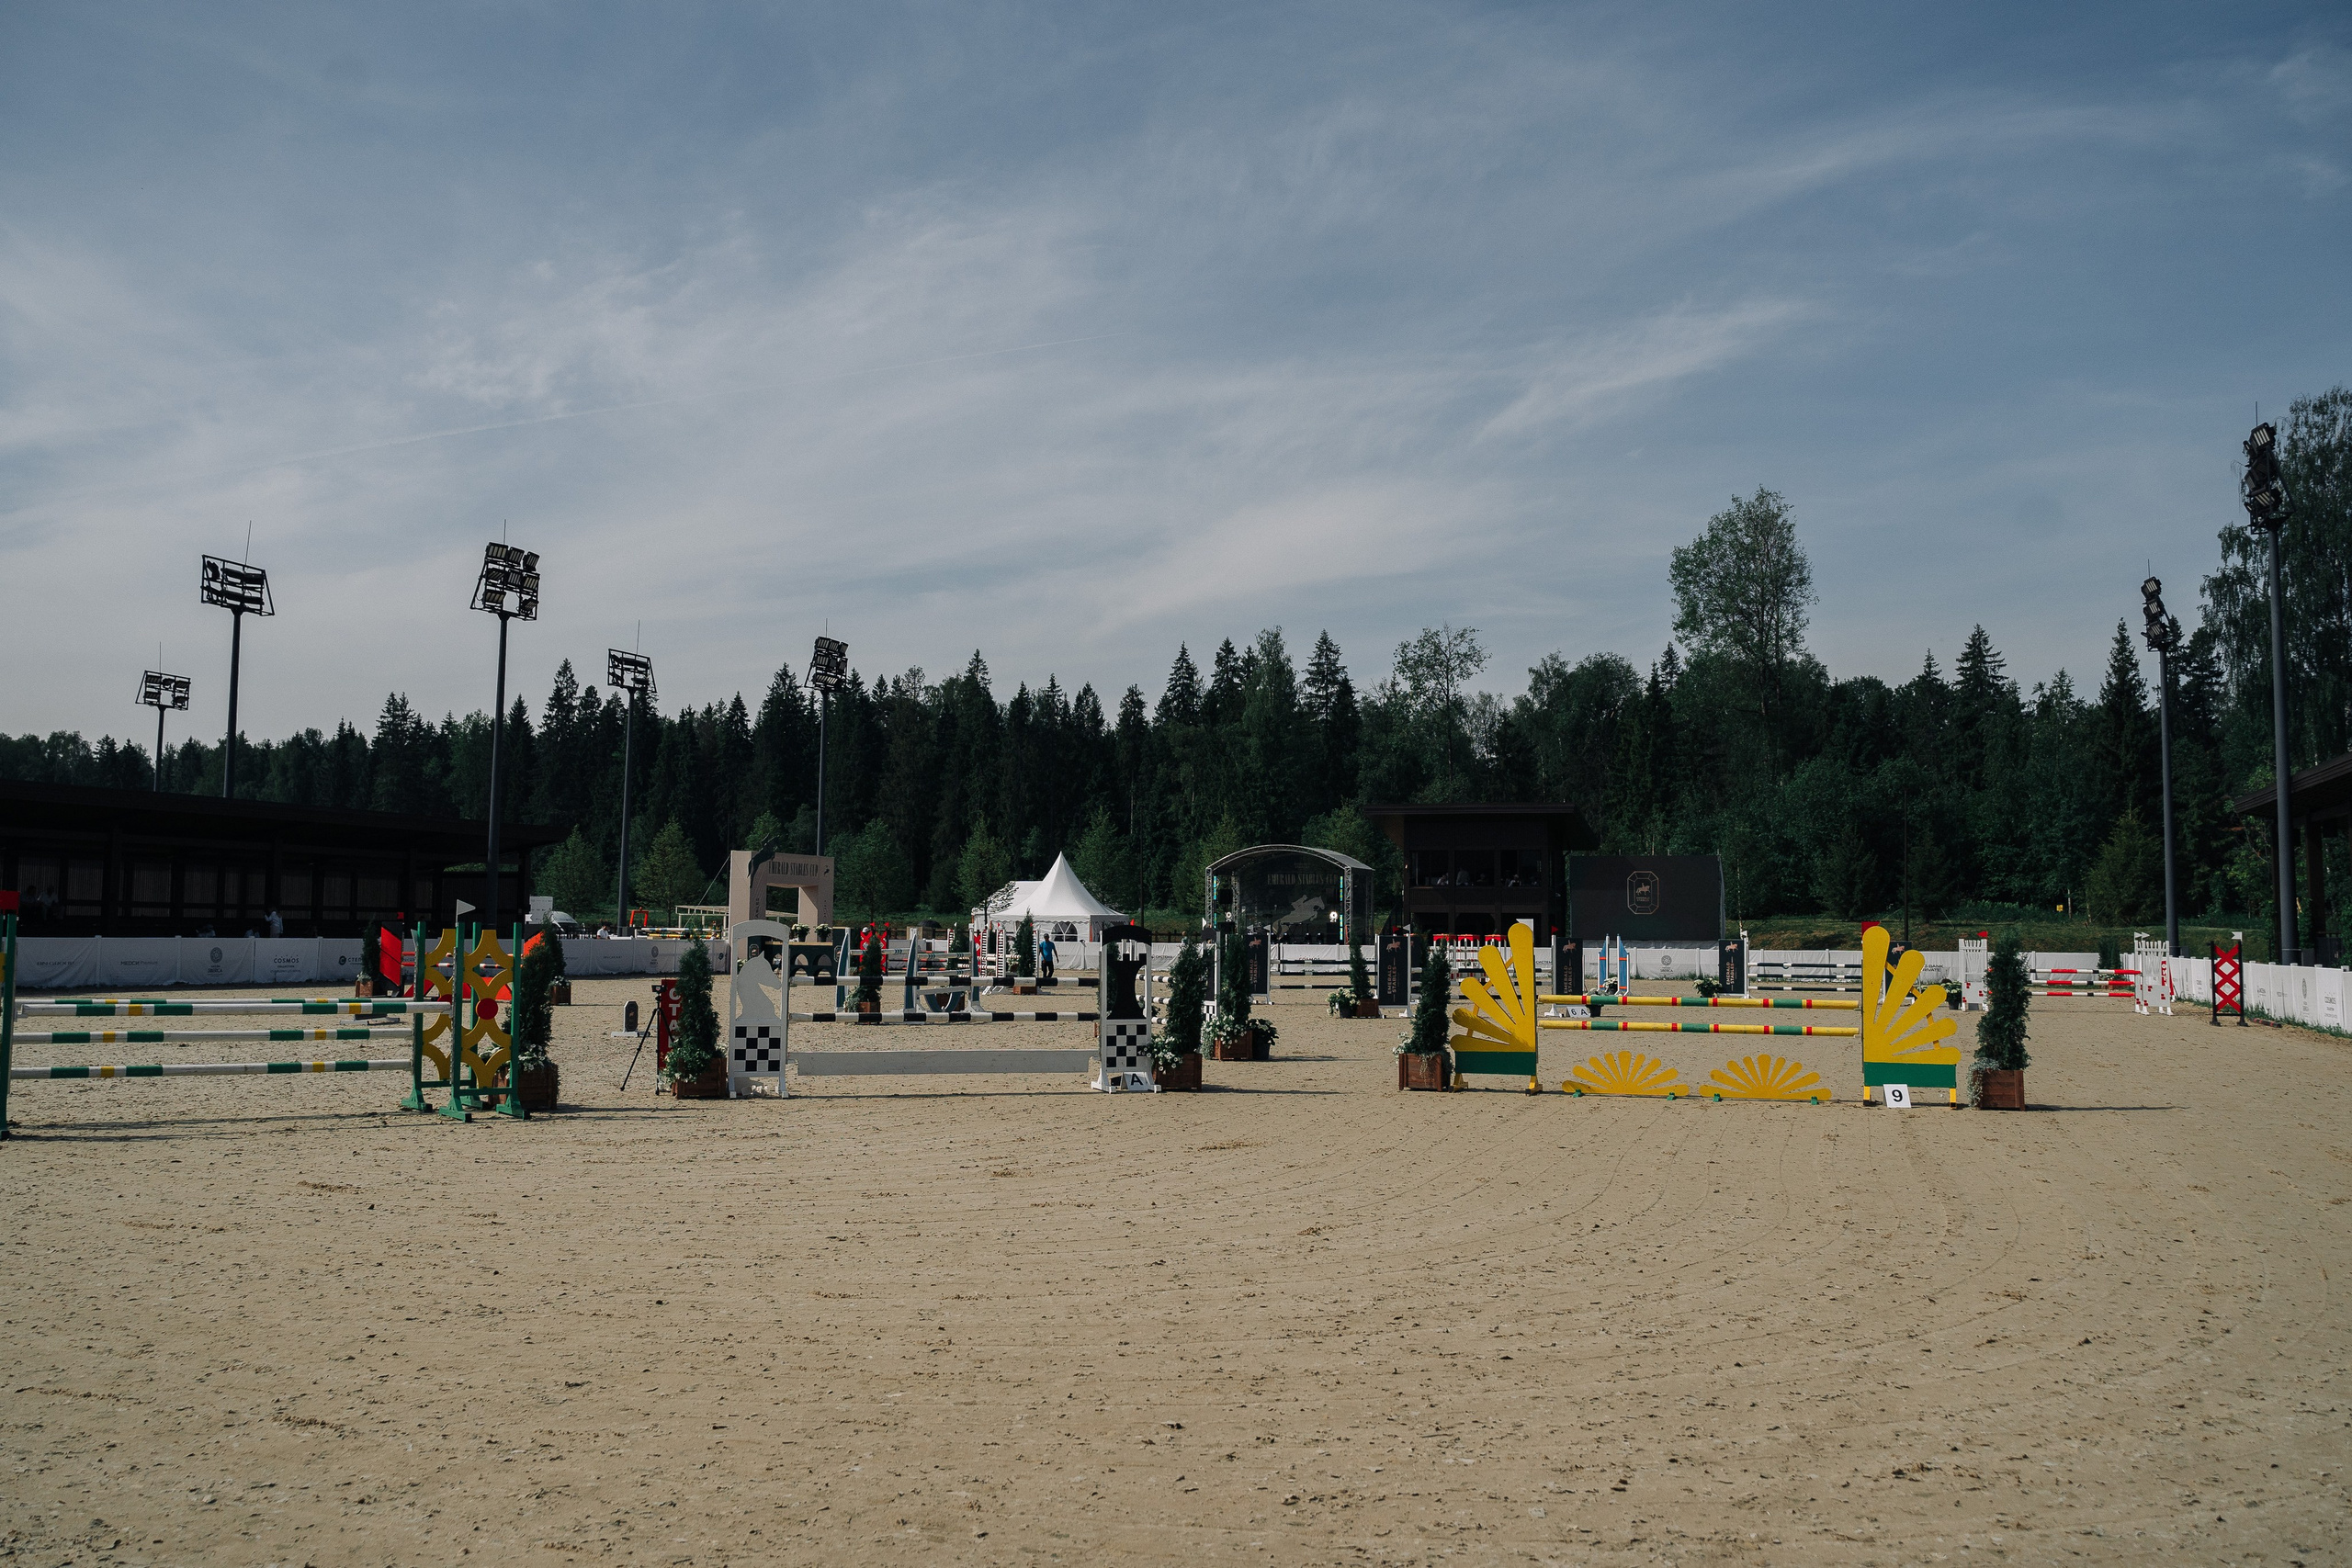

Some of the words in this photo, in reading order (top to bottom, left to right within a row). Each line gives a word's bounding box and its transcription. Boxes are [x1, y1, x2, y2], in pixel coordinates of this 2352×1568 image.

[768, 861, 789, 875] EMERALD
[790, 863, 808, 876] STABLES
[809, 863, 819, 877] CUP
[1267, 874, 1295, 886] EMERALD
[1297, 874, 1323, 886] STABLES
[1131, 1073, 1144, 1086] A
[1892, 1089, 1903, 1102] 9
